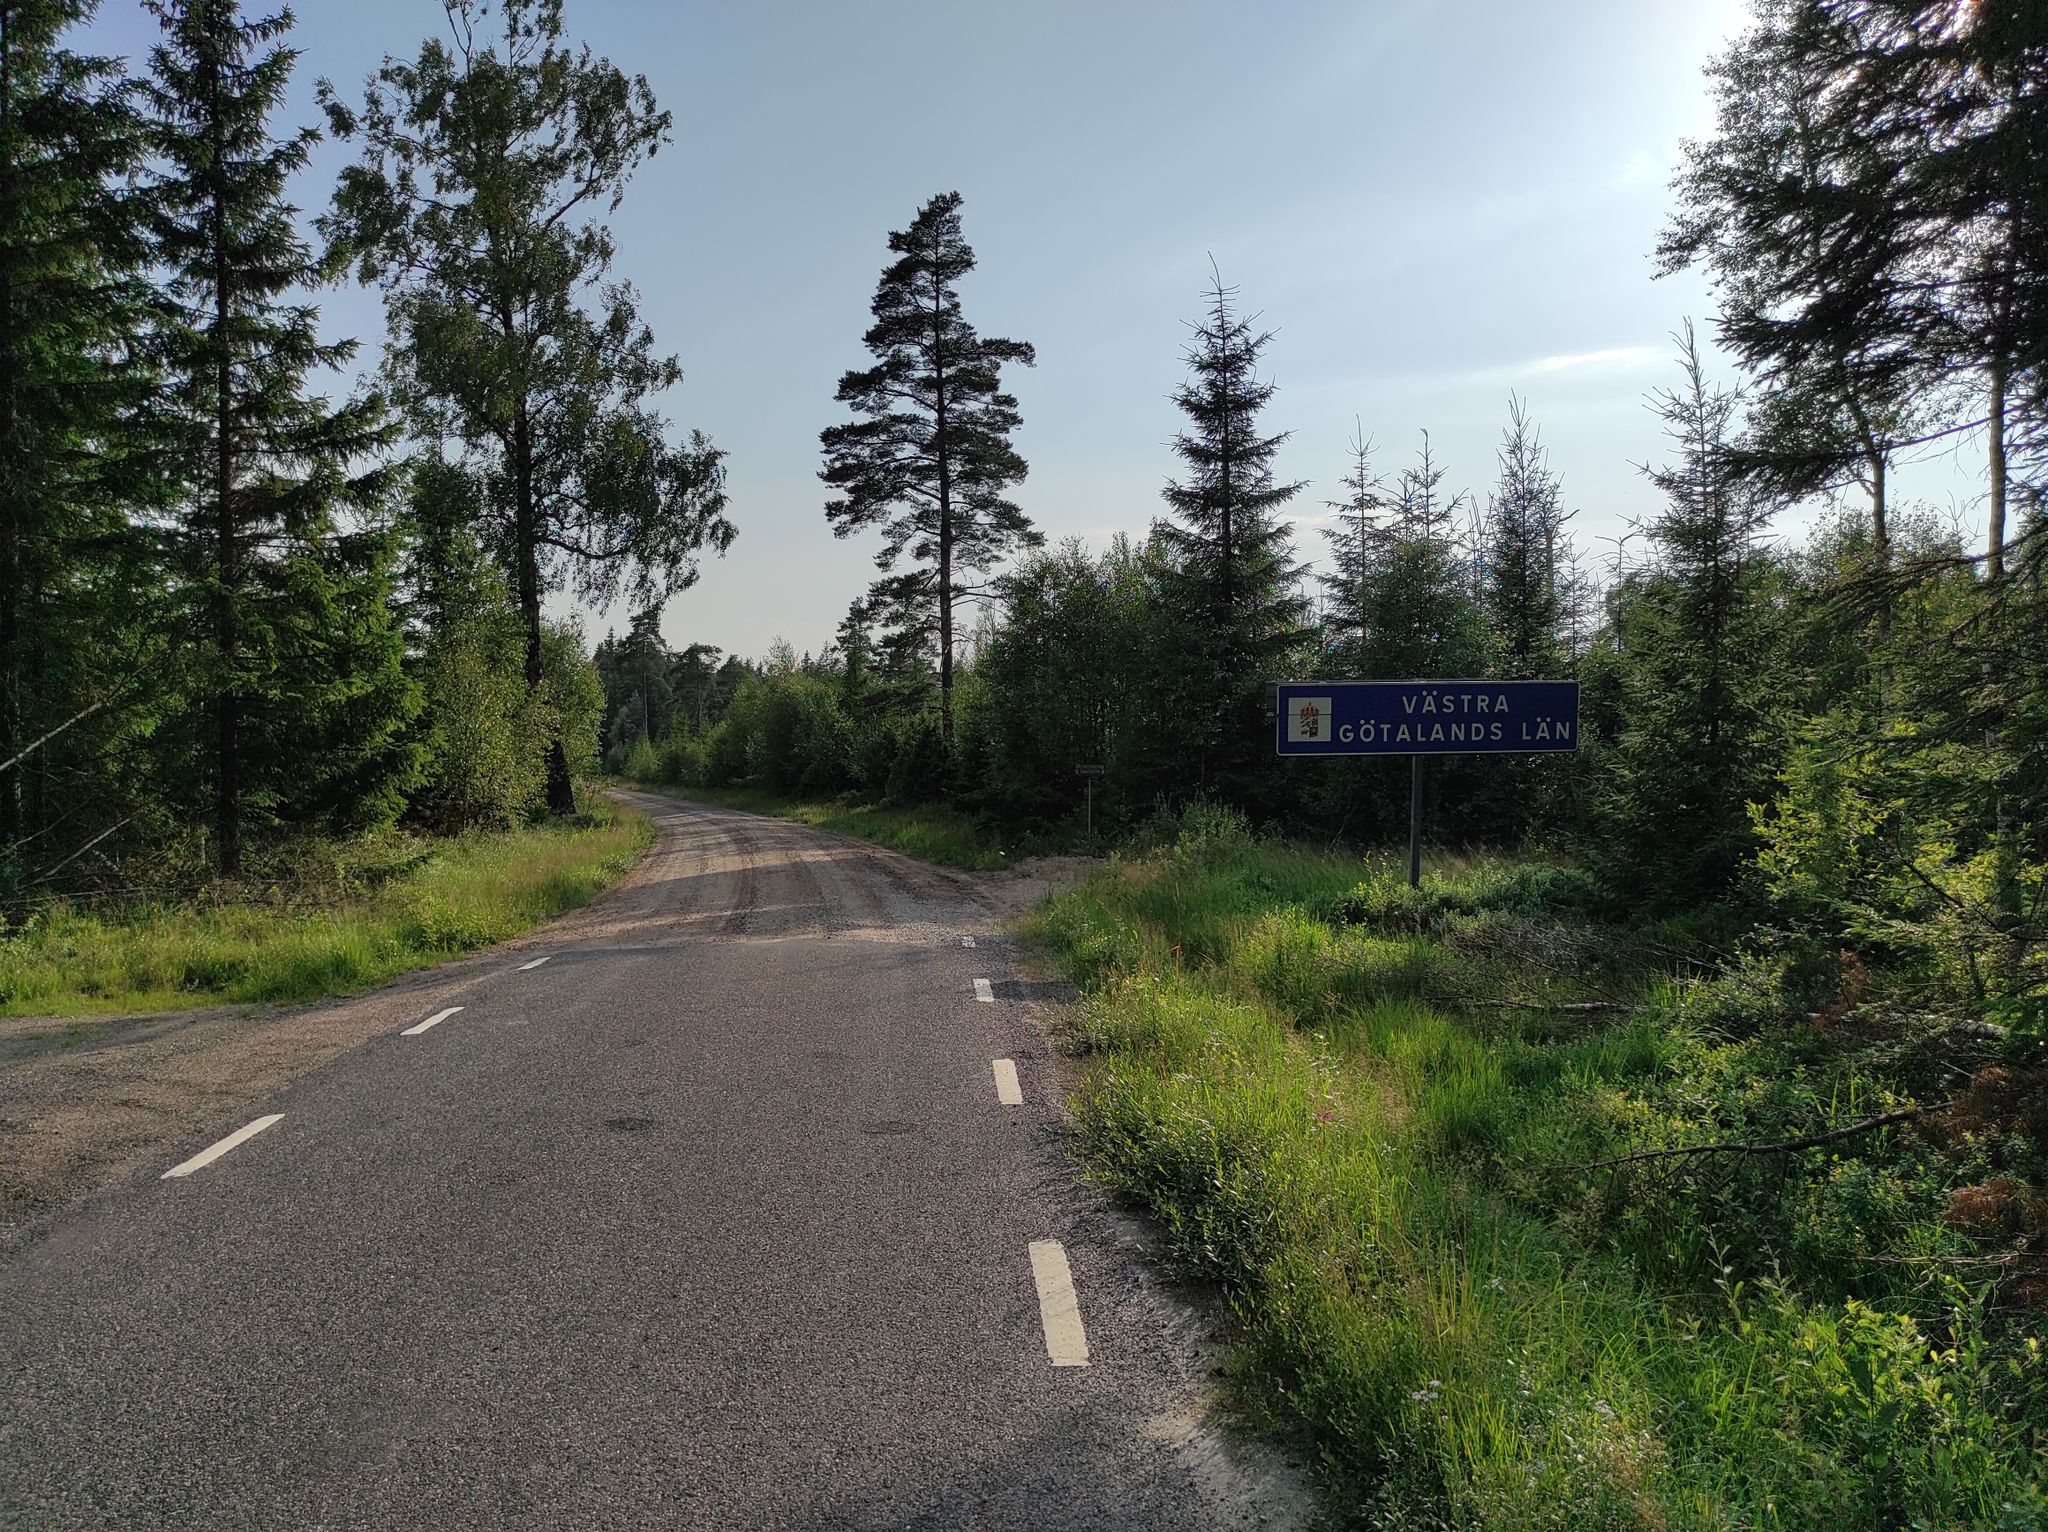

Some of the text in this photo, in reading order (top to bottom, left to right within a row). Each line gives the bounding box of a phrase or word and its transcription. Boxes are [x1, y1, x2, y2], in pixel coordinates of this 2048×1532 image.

[1402, 690, 1508, 713] VÄSTRA
[1339, 717, 1570, 742] GÖTALANDS LÄN
